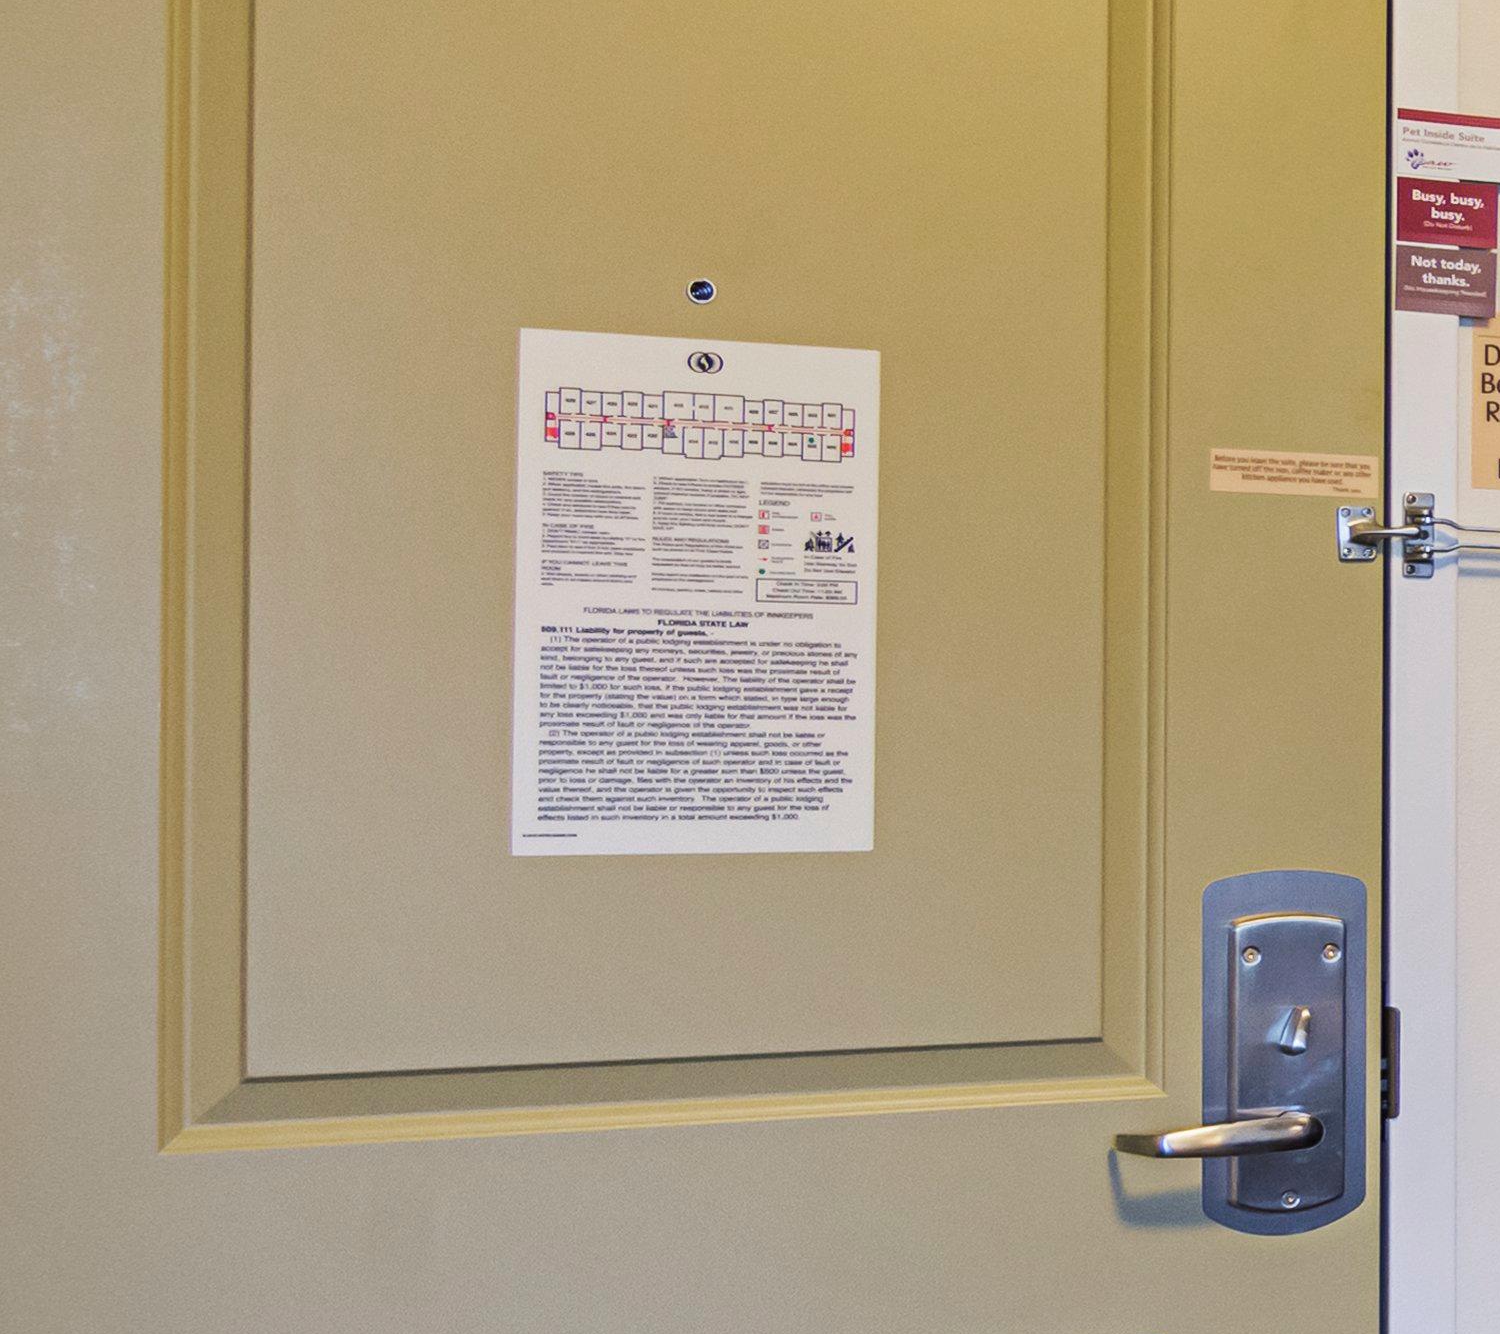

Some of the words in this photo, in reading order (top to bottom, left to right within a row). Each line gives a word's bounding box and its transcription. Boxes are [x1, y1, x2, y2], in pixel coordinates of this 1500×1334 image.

[1402, 126, 1421, 136] Pet
[1424, 129, 1454, 140] Inside
[1459, 132, 1485, 142] Suite
[1412, 189, 1446, 205] Busy,
[1450, 193, 1484, 210] busy,
[1431, 207, 1465, 223] busy.
[1411, 255, 1437, 269] Not
[1441, 259, 1481, 275] today,
[1422, 272, 1470, 287] thanks.
[728, 620, 748, 628] LAW
